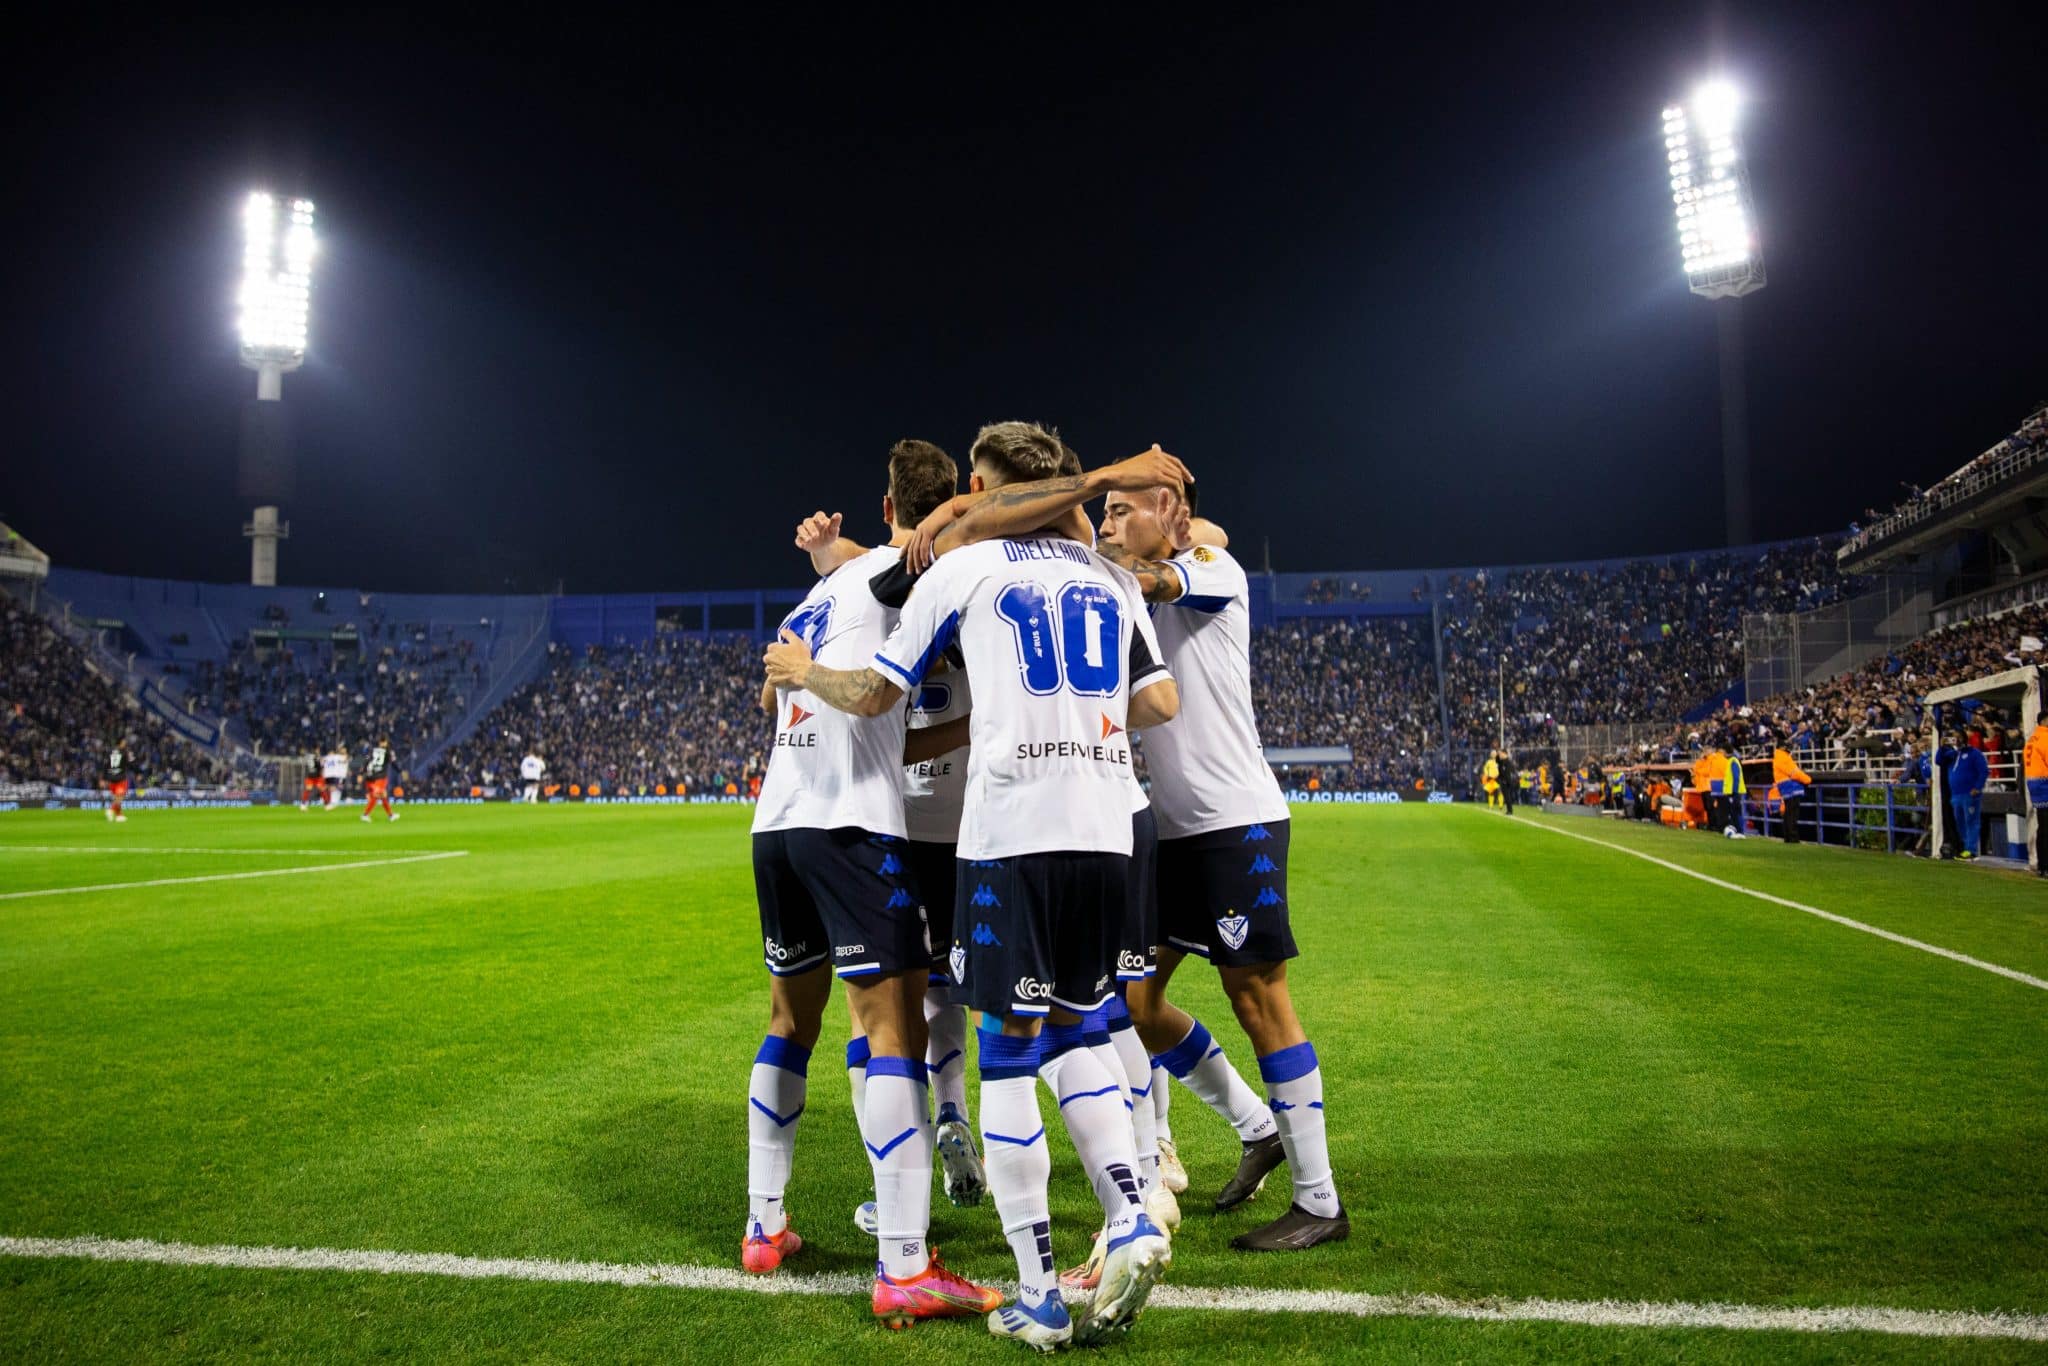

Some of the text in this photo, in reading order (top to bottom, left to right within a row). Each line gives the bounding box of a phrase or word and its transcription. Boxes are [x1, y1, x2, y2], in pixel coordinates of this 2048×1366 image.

[1003, 539, 1090, 566] ORELLANO
[995, 580, 1124, 698] 10
[1312, 791, 1332, 803] AO
[1125, 954, 1144, 968] CO
